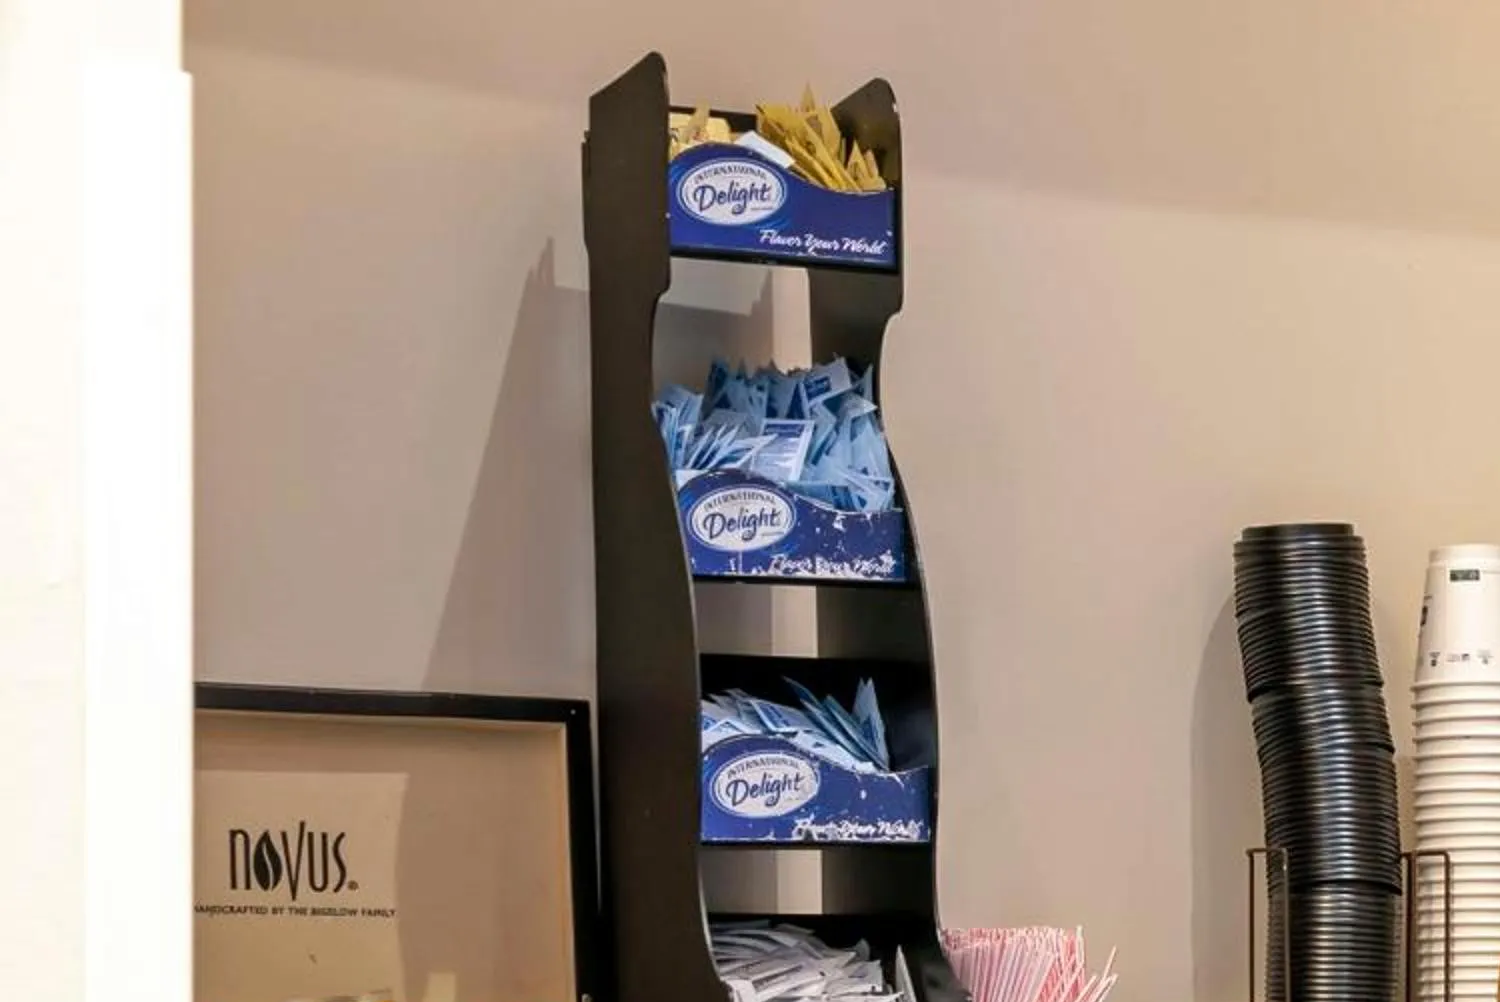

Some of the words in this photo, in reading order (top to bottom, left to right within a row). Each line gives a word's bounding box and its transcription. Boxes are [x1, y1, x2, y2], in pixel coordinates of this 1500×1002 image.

[693, 181, 773, 215] Delight
[704, 490, 776, 512] INTERNATIONAL
[703, 507, 780, 541] Delight
[726, 774, 805, 807] Delight
[271, 906, 284, 916] BY
[288, 906, 308, 916] THE
